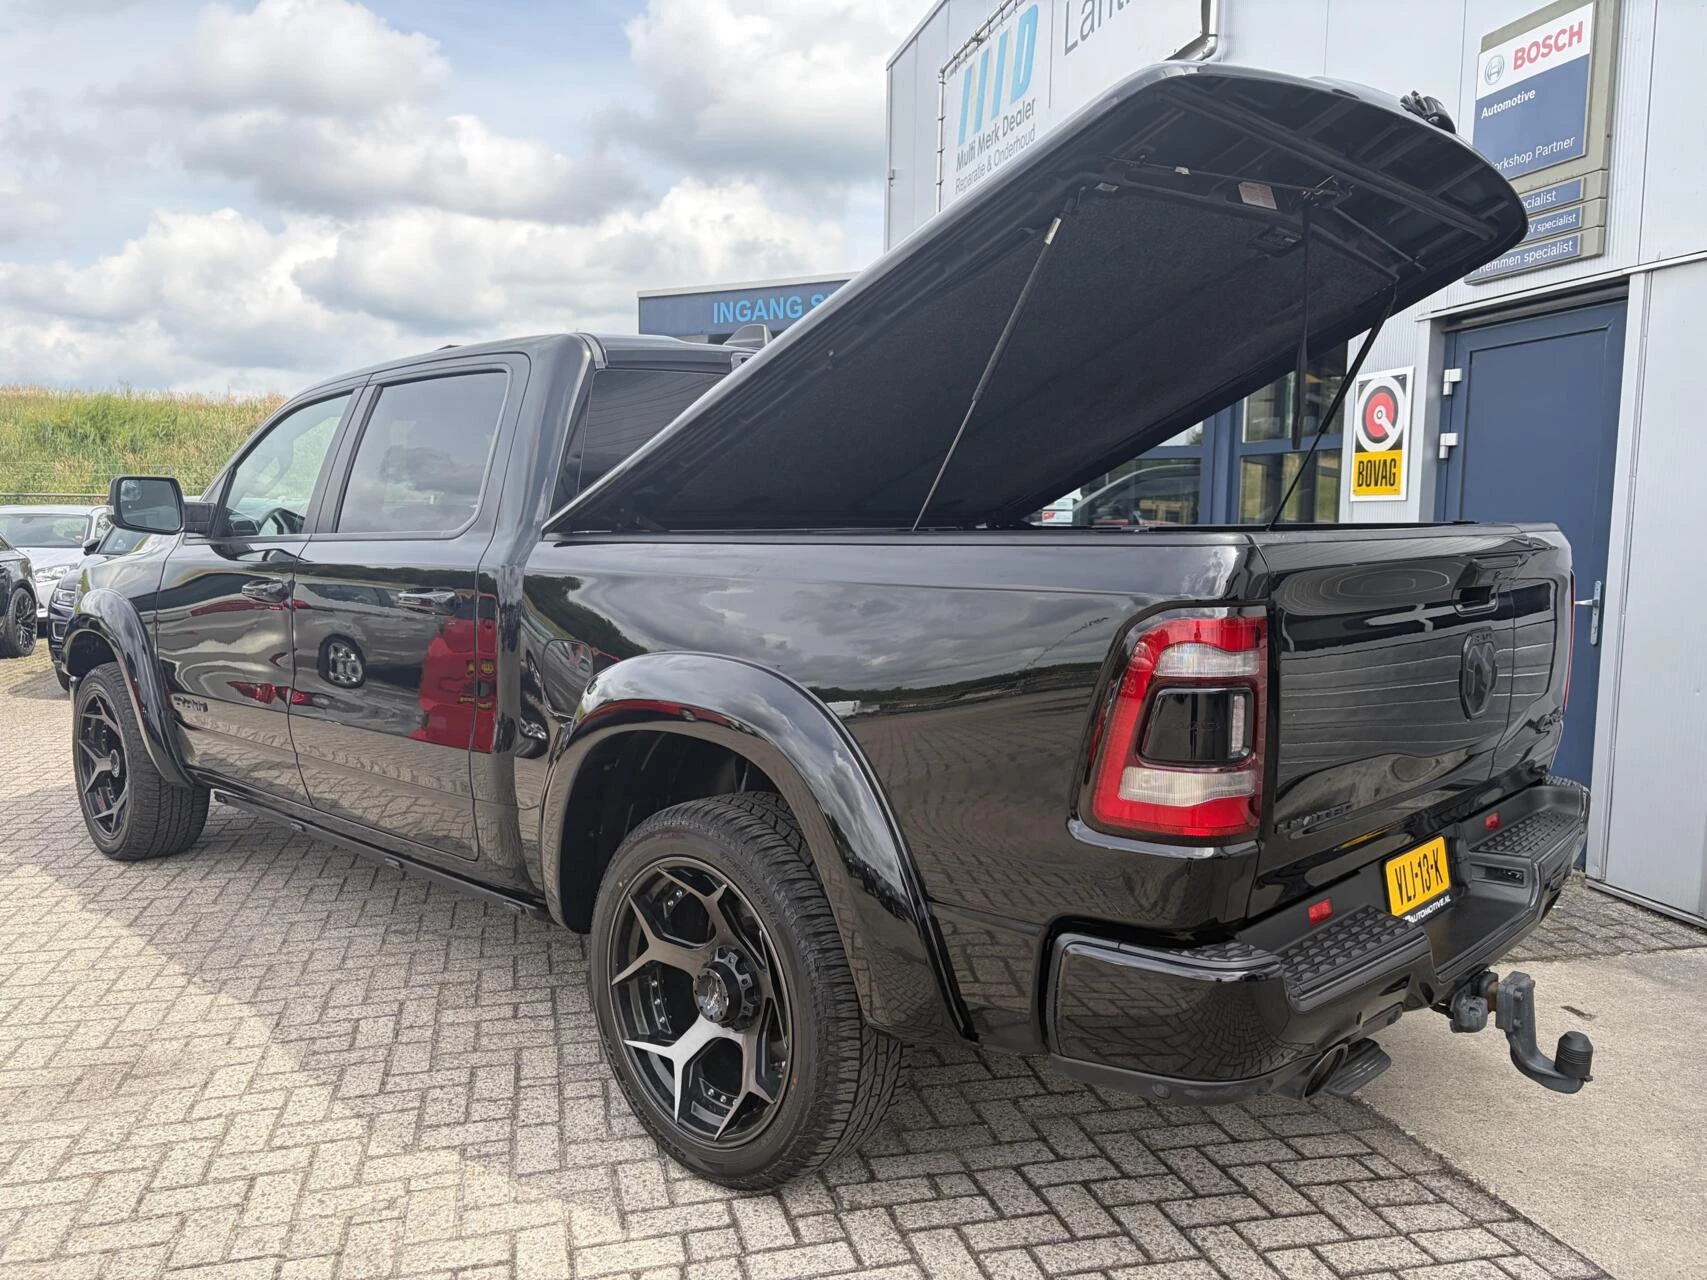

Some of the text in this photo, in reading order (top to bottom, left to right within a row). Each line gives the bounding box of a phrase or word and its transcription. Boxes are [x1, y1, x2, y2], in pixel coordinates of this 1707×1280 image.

[1513, 21, 1583, 70] BOSCH
[1481, 89, 1536, 120] Automotive
[955, 97, 1036, 173] Multi Merk Dealer
[1535, 136, 1576, 158] Partner
[1537, 213, 1577, 232] specialist
[1523, 240, 1574, 263] specialist
[713, 295, 802, 324] INGANG
[1357, 458, 1397, 488] BOVAG
[1394, 846, 1443, 906] VLJ-13-K
